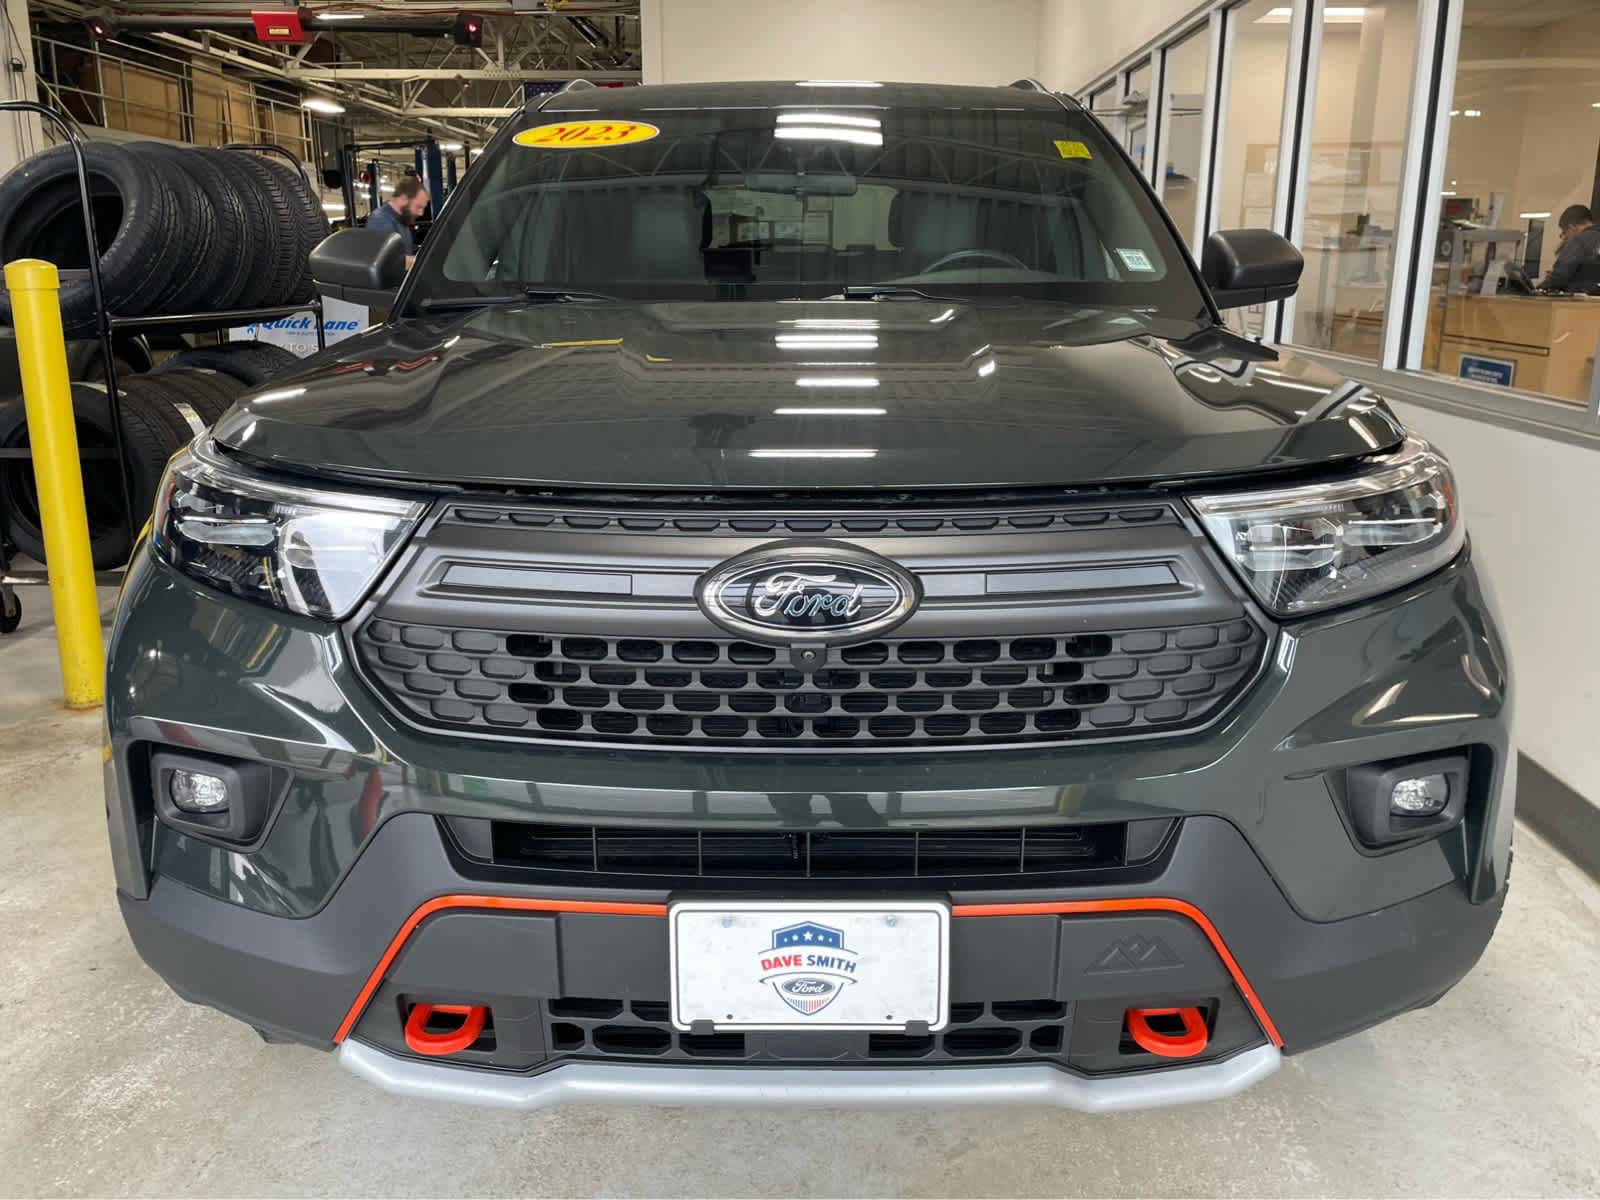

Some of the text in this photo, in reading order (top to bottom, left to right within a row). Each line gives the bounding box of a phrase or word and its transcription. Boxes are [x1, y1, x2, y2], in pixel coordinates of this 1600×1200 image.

[533, 125, 638, 143] 2023
[313, 319, 359, 331] ane
[754, 571, 864, 617] Ford
[761, 954, 857, 974] DAVE SMITH
[791, 980, 826, 993] Ford
